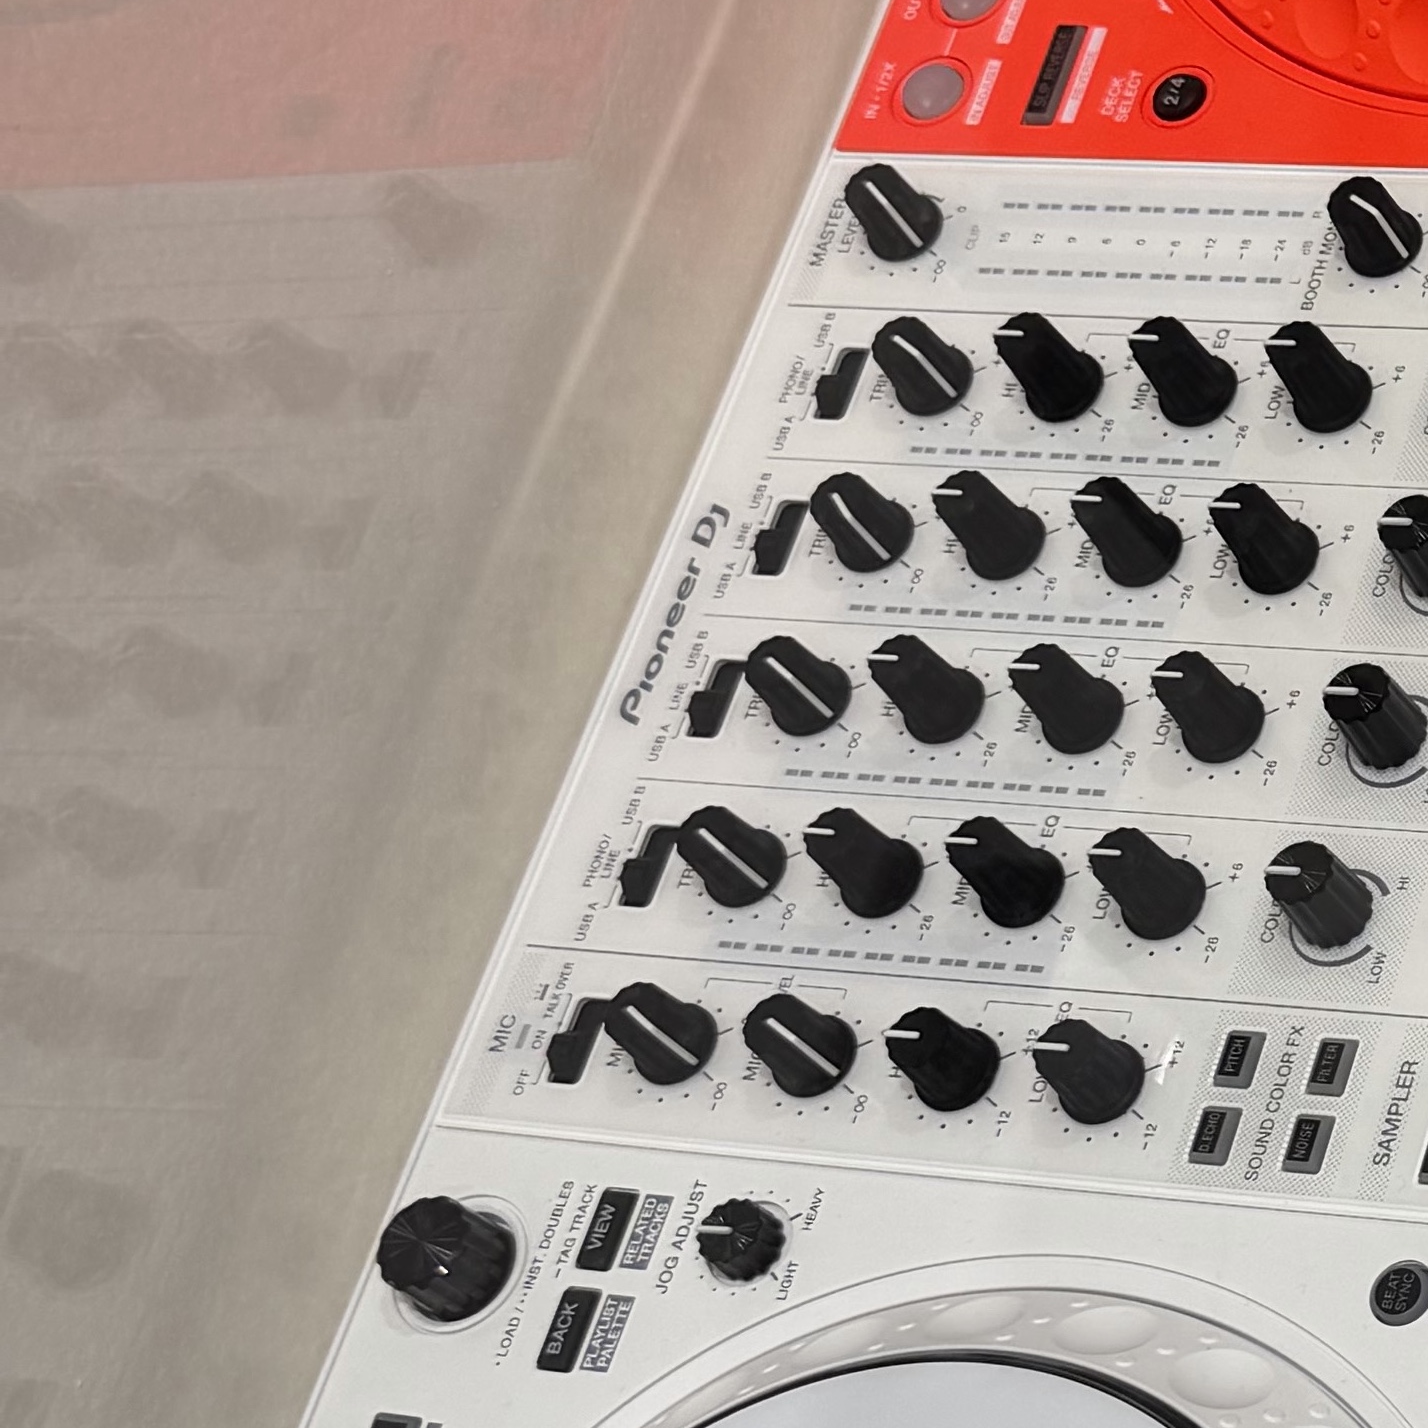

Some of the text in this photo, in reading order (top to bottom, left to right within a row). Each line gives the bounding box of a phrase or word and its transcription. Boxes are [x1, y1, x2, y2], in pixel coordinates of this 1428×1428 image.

[809, 198, 846, 267] MASTER
[1300, 259, 1329, 312] BOOTH
[619, 503, 731, 727] Pioneer DJ
[1224, 1038, 1248, 1073] PITCH
[1244, 1024, 1305, 1182] SOUND COLOR FX
[1372, 1059, 1420, 1167] SAMPLER
[1291, 1121, 1315, 1159] NOISE
[538, 1180, 575, 1250] DOUBLES
[585, 1203, 617, 1251] VIEW
[637, 1202, 671, 1262] TRACKS
[654, 1178, 709, 1295] JOG ADJUST
[776, 1260, 801, 1301] LIGHT
[547, 1302, 580, 1356] BACK
